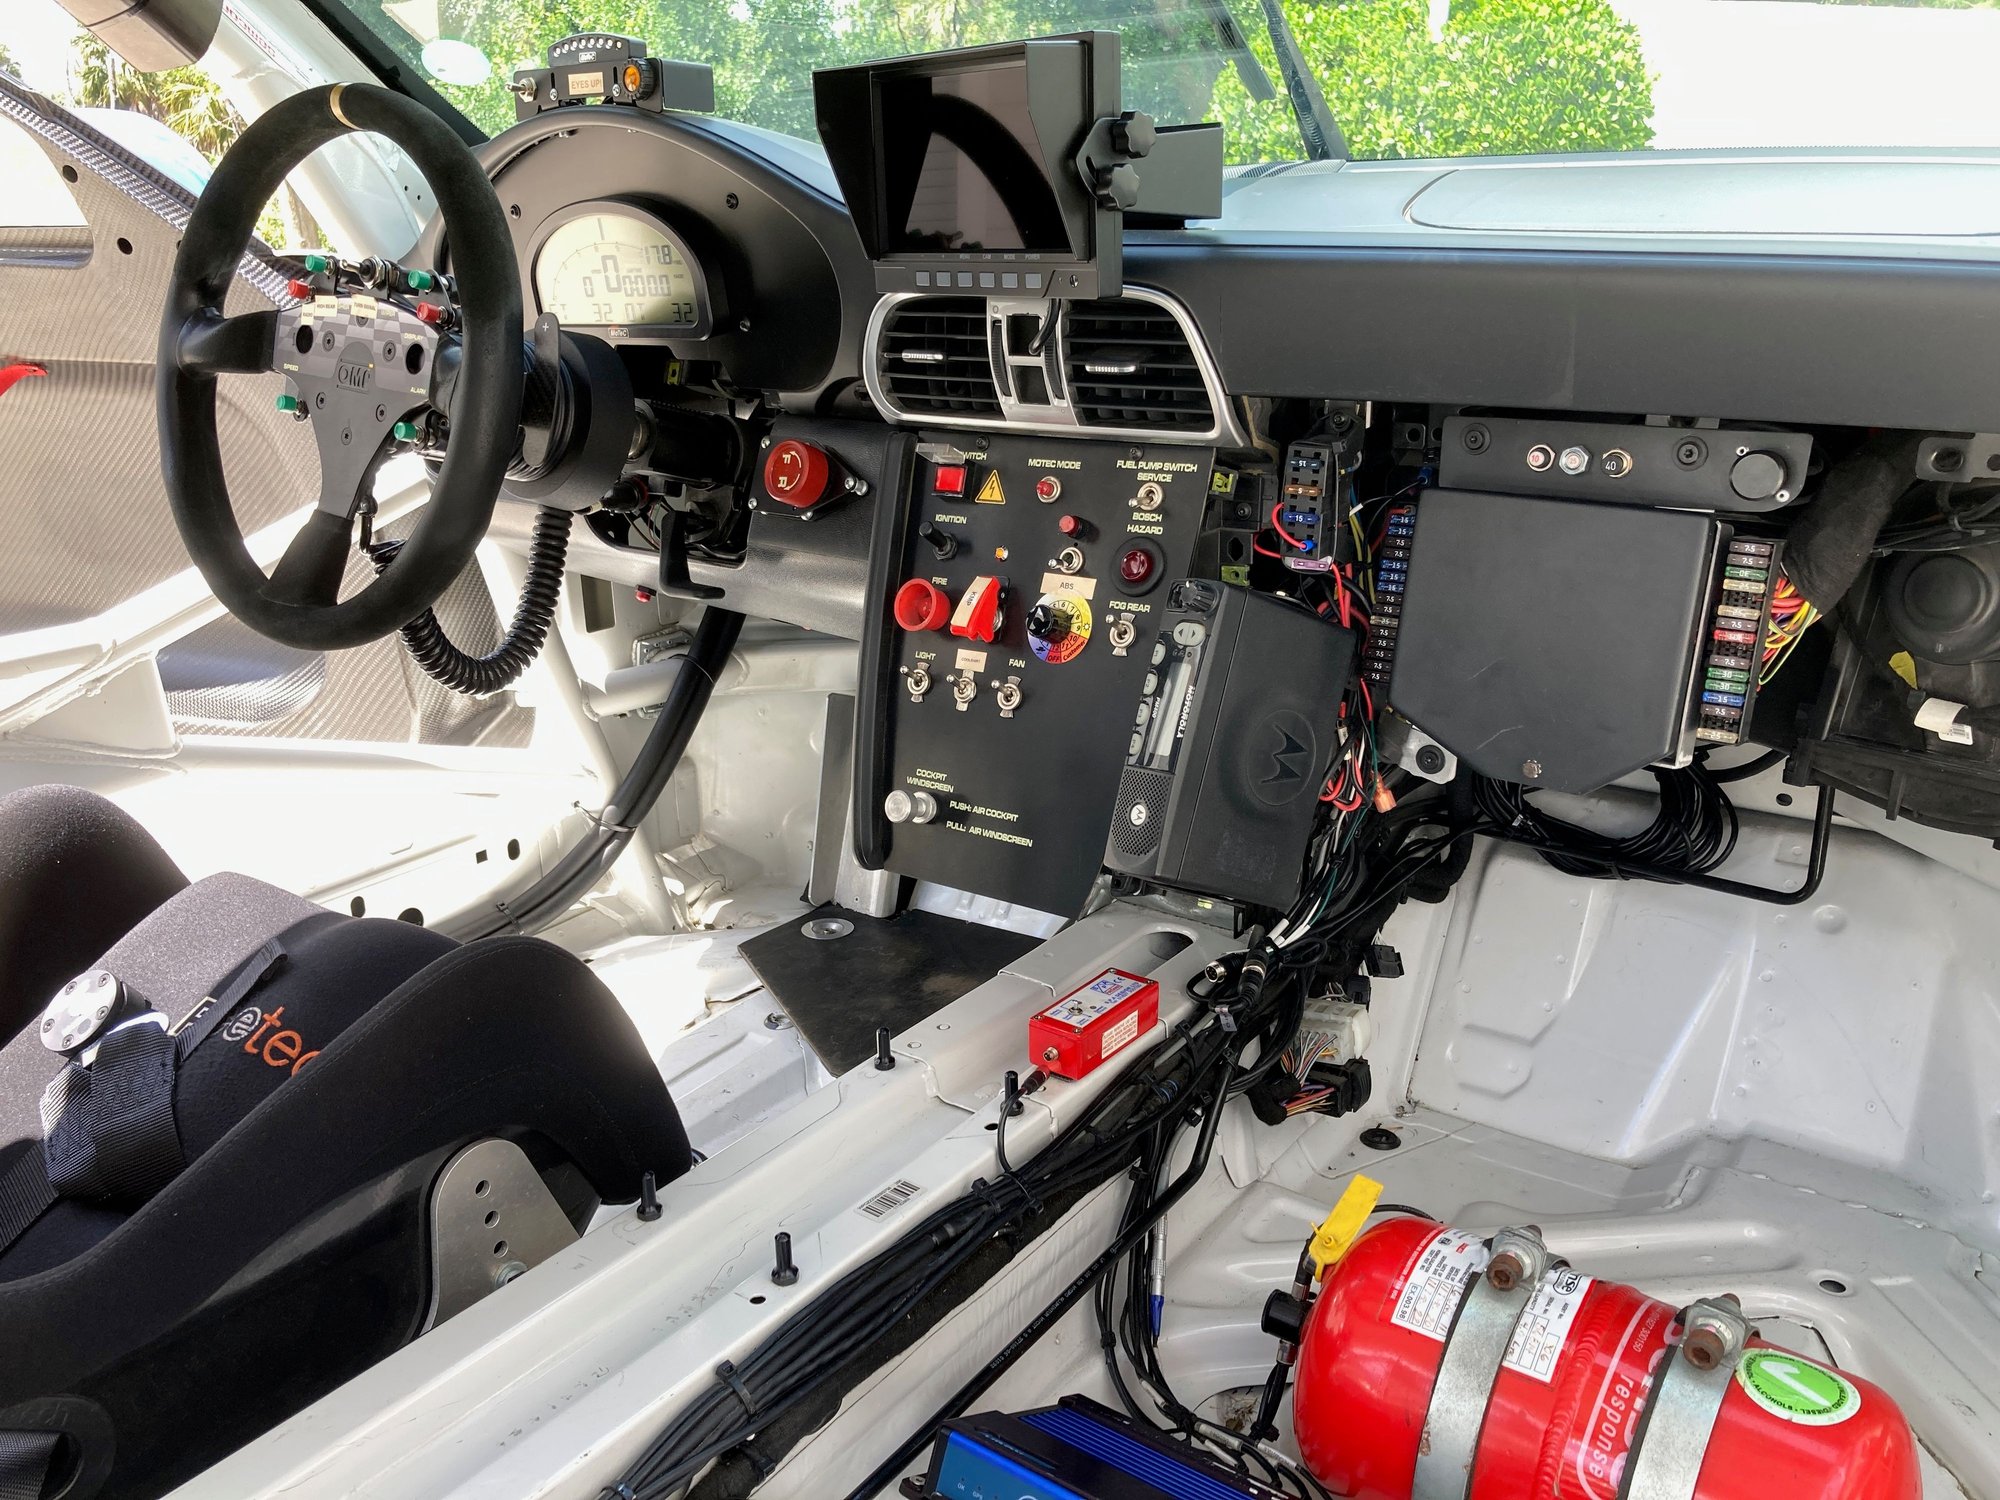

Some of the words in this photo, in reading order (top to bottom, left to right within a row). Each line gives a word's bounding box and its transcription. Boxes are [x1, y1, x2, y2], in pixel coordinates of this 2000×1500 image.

[571, 79, 589, 90] EYES
[672, 303, 694, 323] 32
[403, 333, 424, 342] DISPLAY
[283, 363, 299, 372] SPEED
[410, 386, 428, 395] ALARM
[782, 454, 792, 465] F
[1531, 455, 1540, 463] 10
[1056, 460, 1082, 470] MODE
[1116, 459, 1138, 470] FUEL
[1138, 461, 1164, 472] PUMP
[1164, 463, 1198, 473] SWITCH
[1605, 461, 1617, 472] 40
[778, 476, 788, 488] R
[1137, 472, 1173, 483] SERVICE
[935, 513, 968, 525] IGNITION
[1132, 512, 1163, 523] BOSCH
[1127, 524, 1163, 535] HAZARD
[931, 576, 948, 586] FIRE
[1059, 582, 1075, 590] ABS
[1109, 600, 1128, 610] FOG
[1128, 602, 1151, 613] REAR
[915, 651, 937, 661] LIGHT
[1008, 658, 1026, 668] FAN
[1176, 685, 1196, 738] MOTOROLA
[916, 768, 948, 781] COCKPIT
[906, 776, 954, 793] WINDSCREEN
[949, 800, 972, 813] PUSH:
[972, 805, 986, 816] AIR
[986, 808, 1019, 823] COCKPIT
[946, 820, 967, 832] PULL:
[968, 826, 983, 836] AIR
[983, 828, 1033, 848] WINDSCREEN
[1400, 1285, 1418, 1319] EX.003.98
[1589, 1374, 1634, 1478] response
